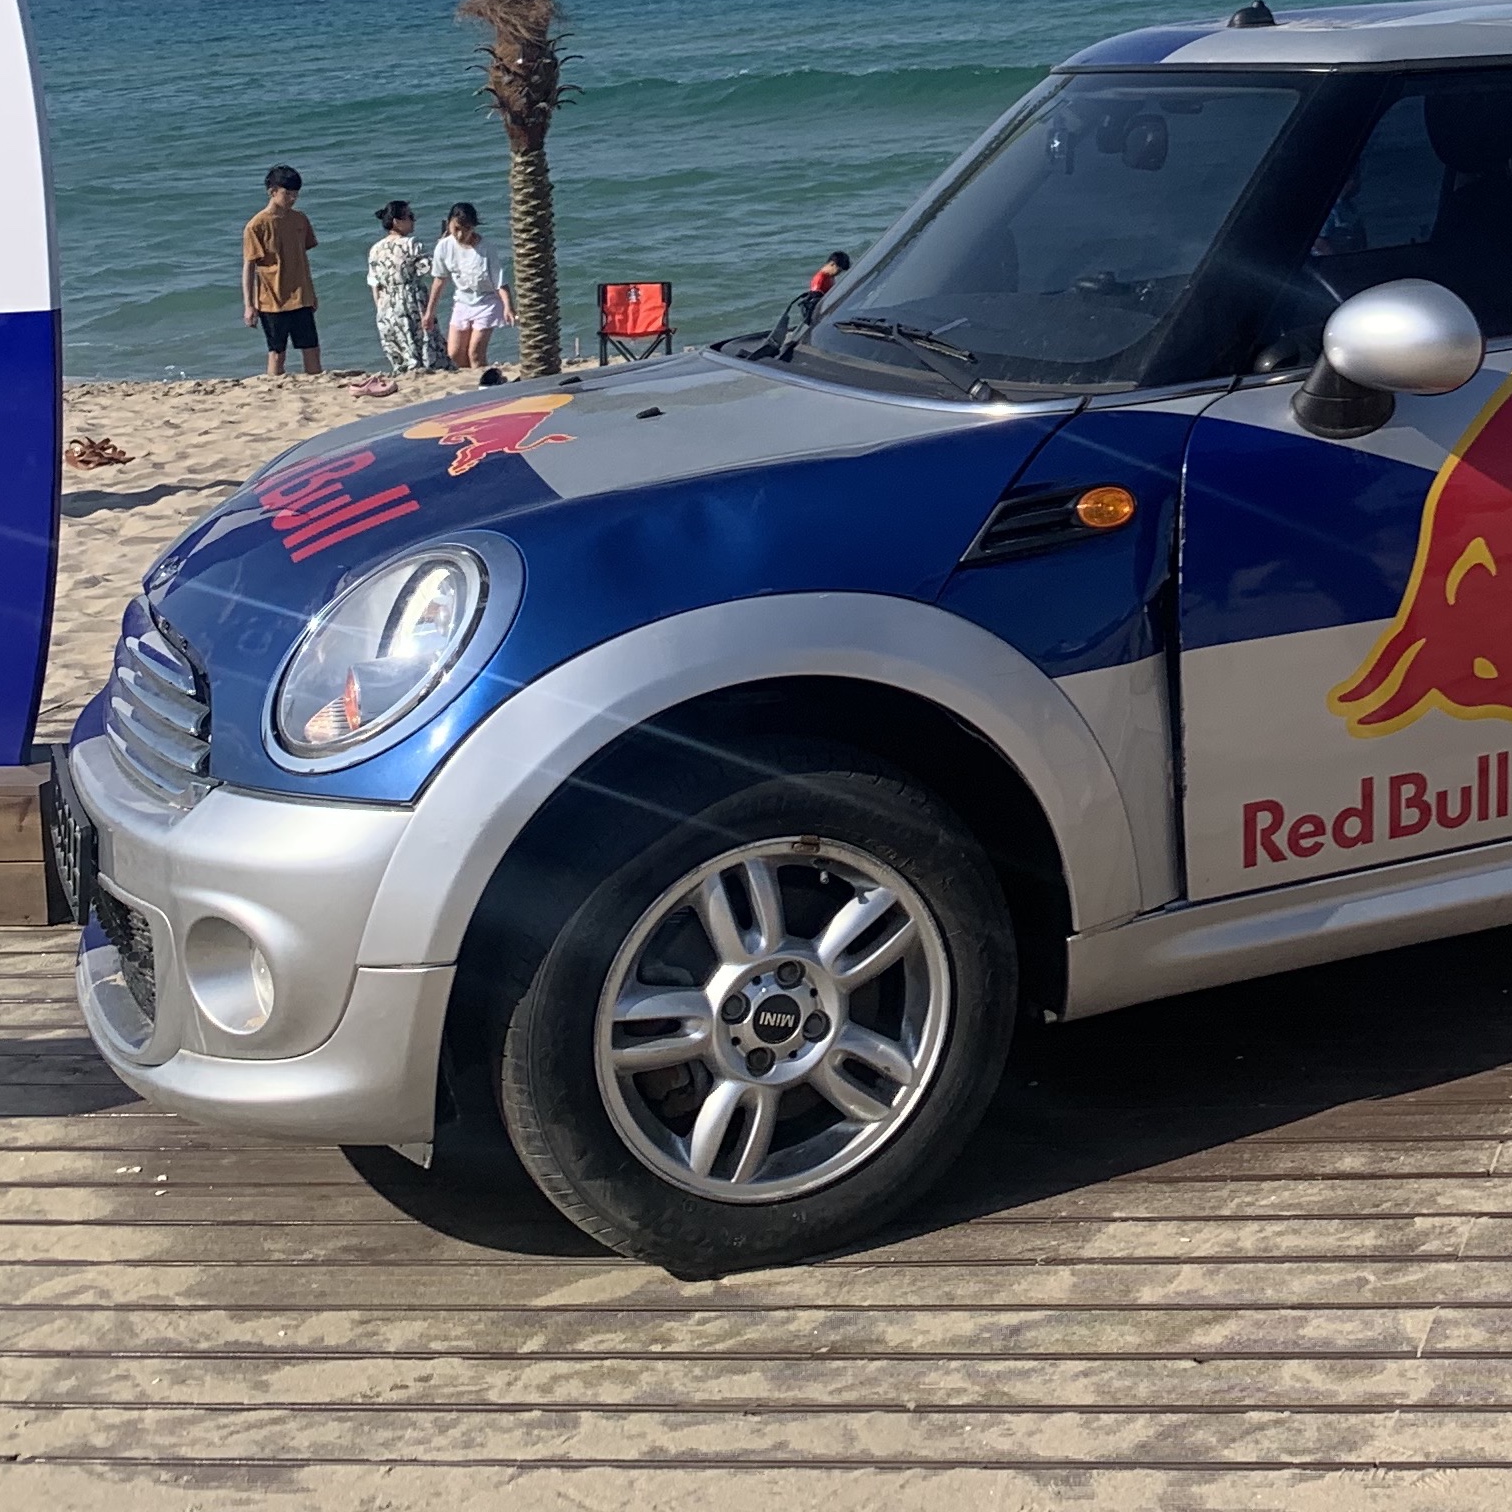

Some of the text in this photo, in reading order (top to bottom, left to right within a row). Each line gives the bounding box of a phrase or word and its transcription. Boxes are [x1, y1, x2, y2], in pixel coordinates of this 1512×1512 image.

[259, 450, 420, 563] Bull
[1242, 750, 1510, 869] Red Bull
[759, 1011, 796, 1028] MINI
